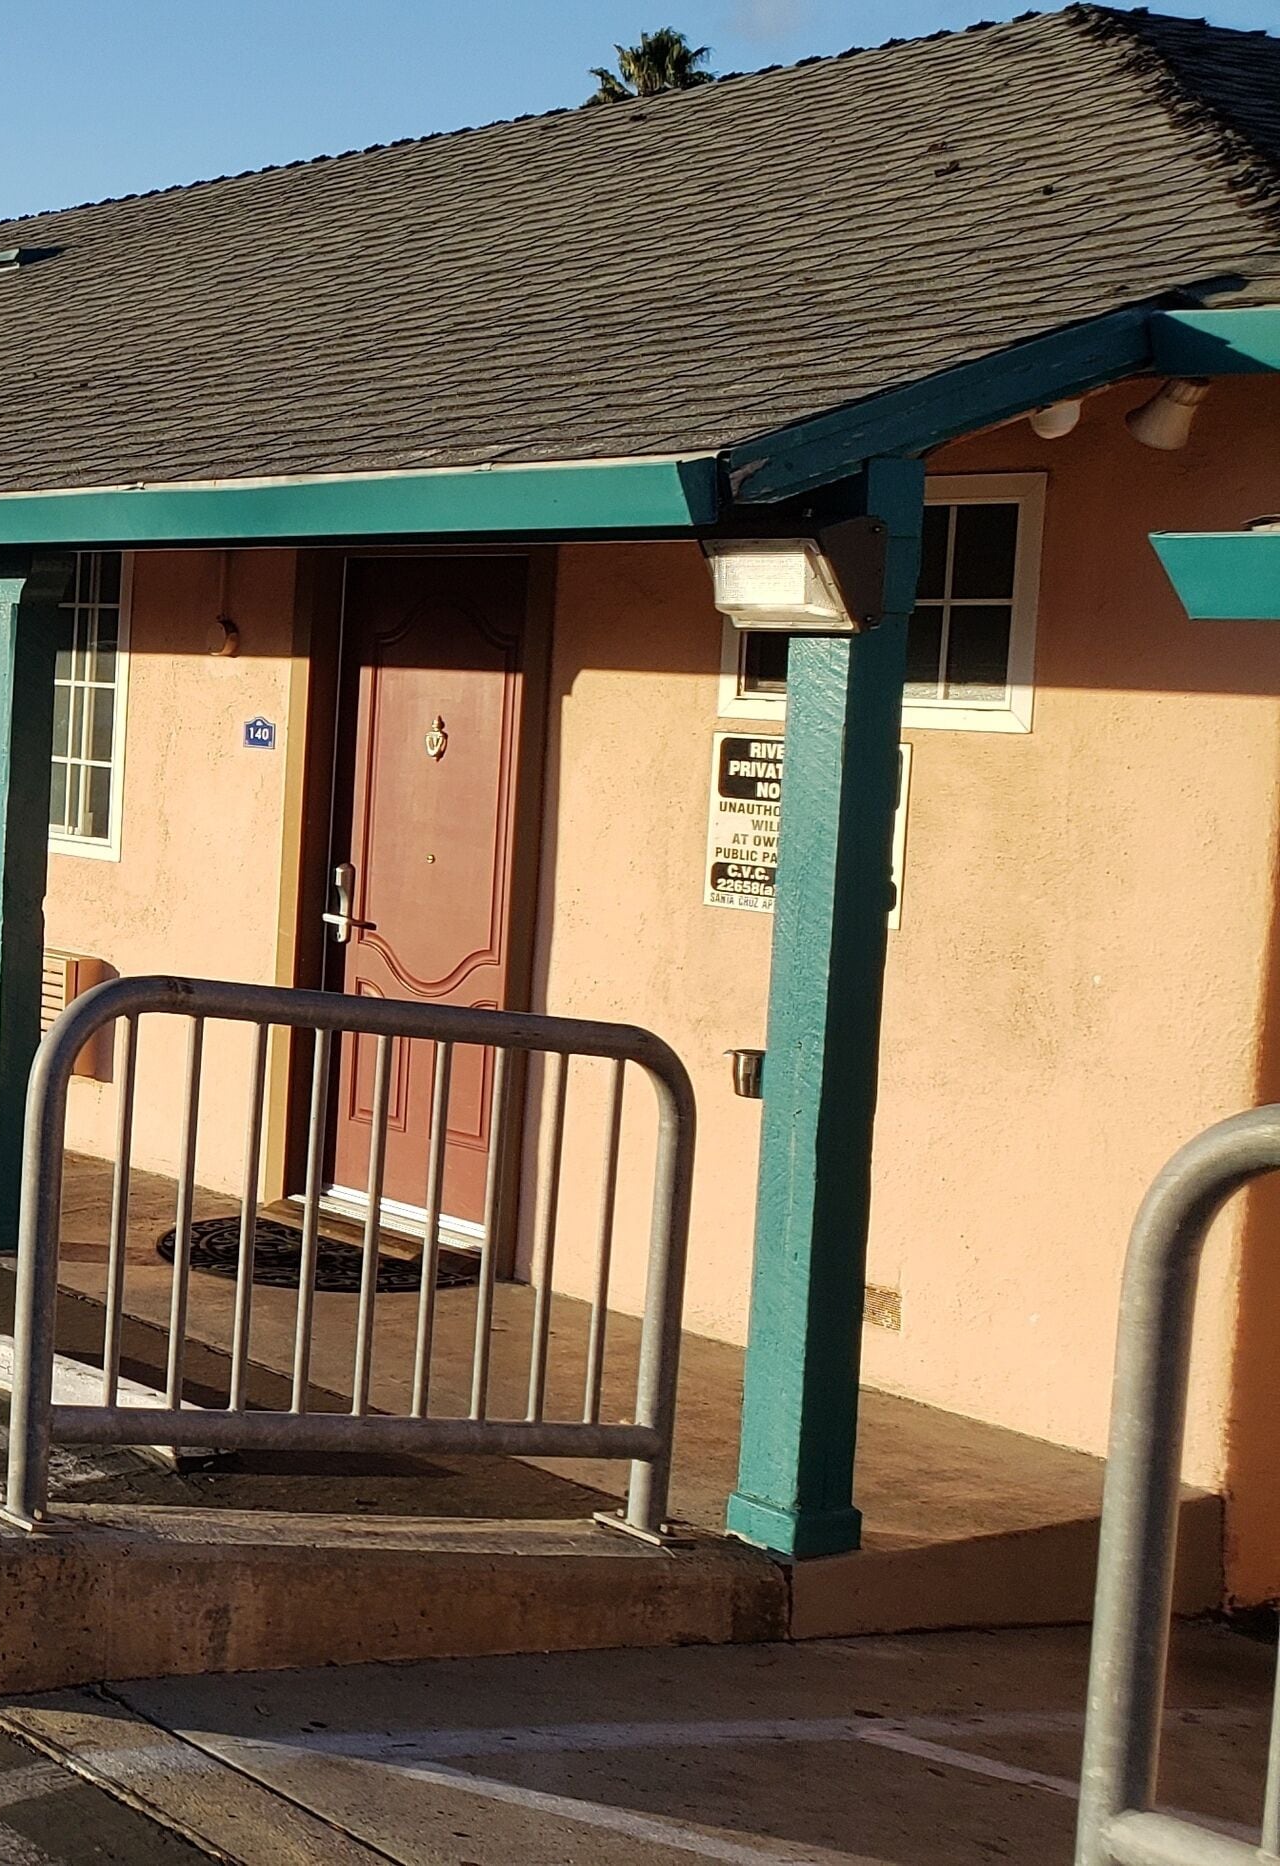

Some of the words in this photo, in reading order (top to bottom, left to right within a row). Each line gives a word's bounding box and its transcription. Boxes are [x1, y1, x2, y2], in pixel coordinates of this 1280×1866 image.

[249, 727, 269, 740] 140
[756, 781, 780, 799] NO
[732, 833, 749, 845] AT
[715, 847, 758, 862] PUBLIC
[726, 864, 770, 881] C.V.C.
[710, 892, 735, 905] SANTA
[738, 896, 759, 908] CRUZ
